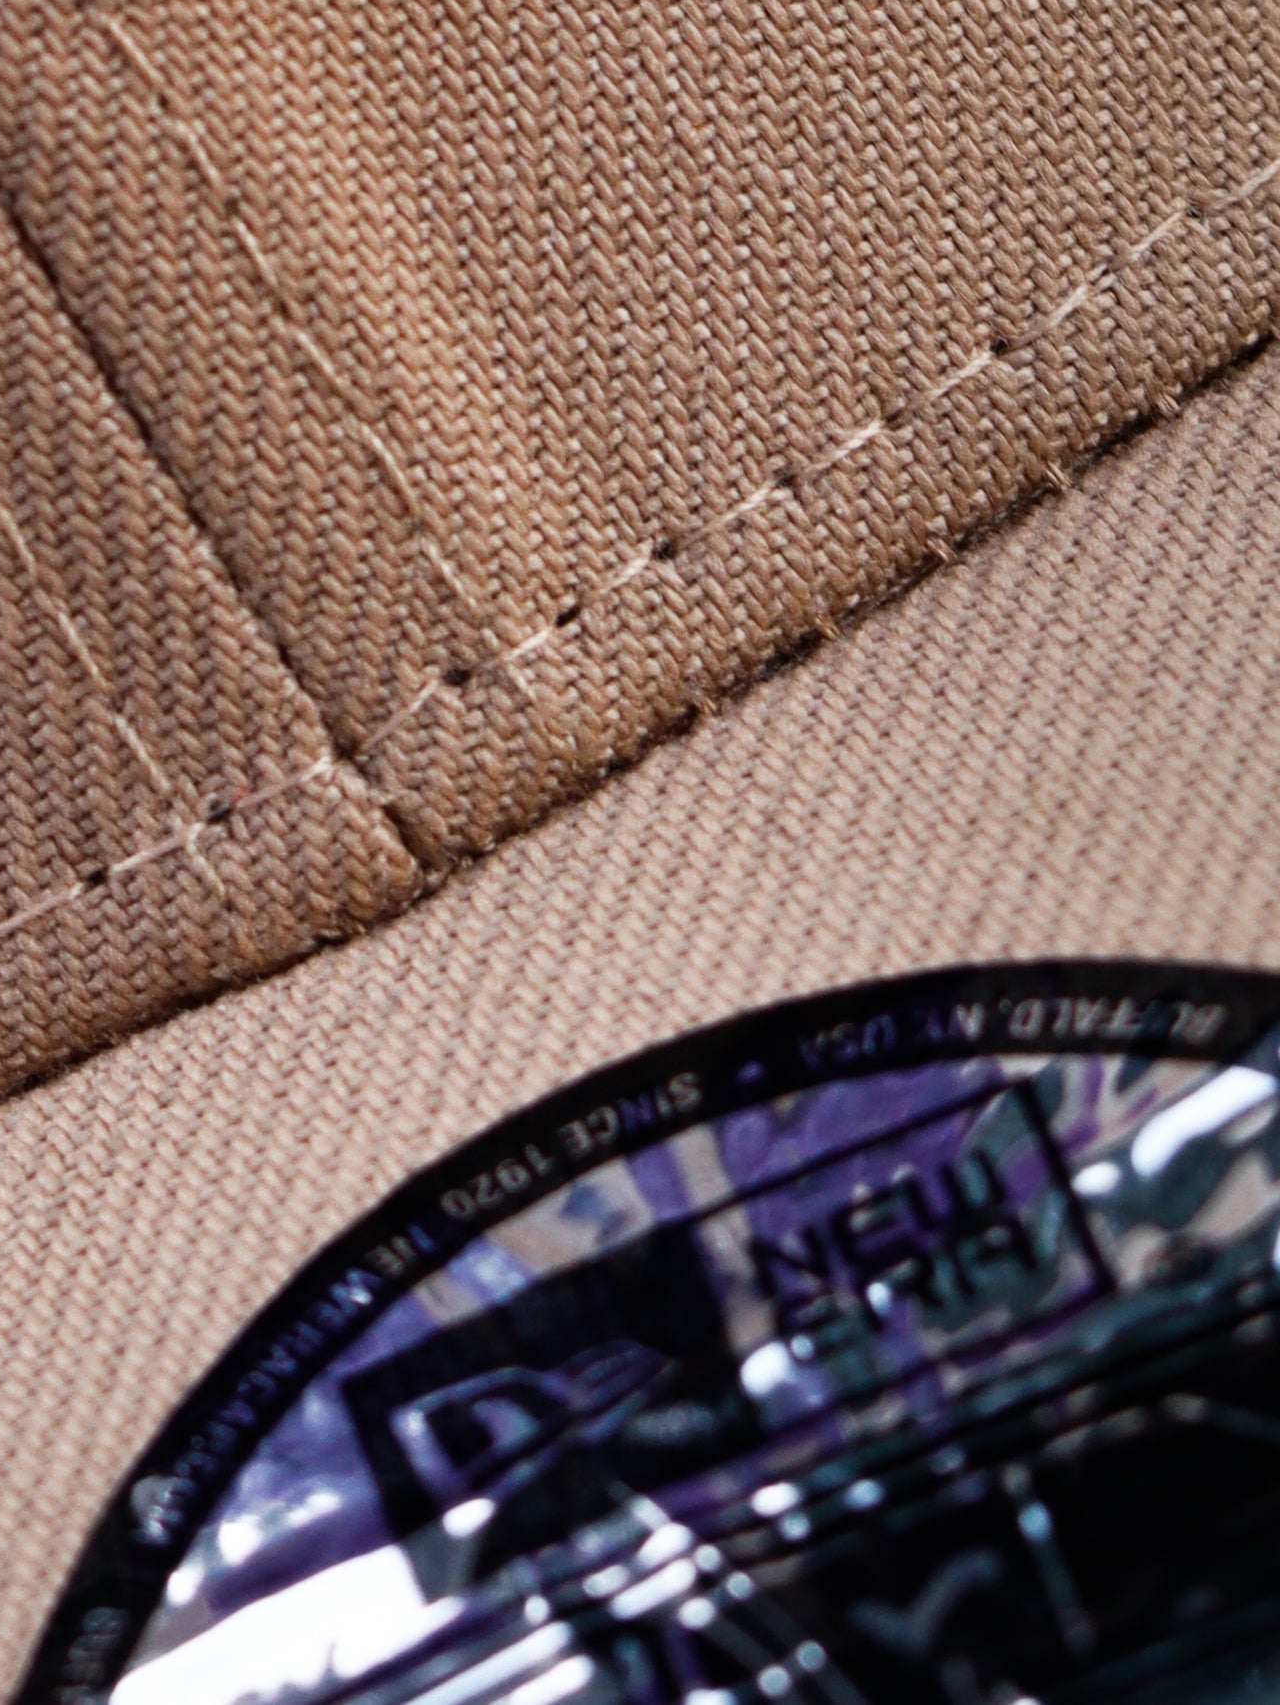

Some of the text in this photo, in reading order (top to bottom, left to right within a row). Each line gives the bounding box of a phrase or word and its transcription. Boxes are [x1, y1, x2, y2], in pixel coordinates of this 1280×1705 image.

[555, 1071, 705, 1161] SINCE
[438, 1142, 557, 1223] 1920
[747, 1147, 1006, 1296] NEW
[774, 1214, 1038, 1362] ERA
